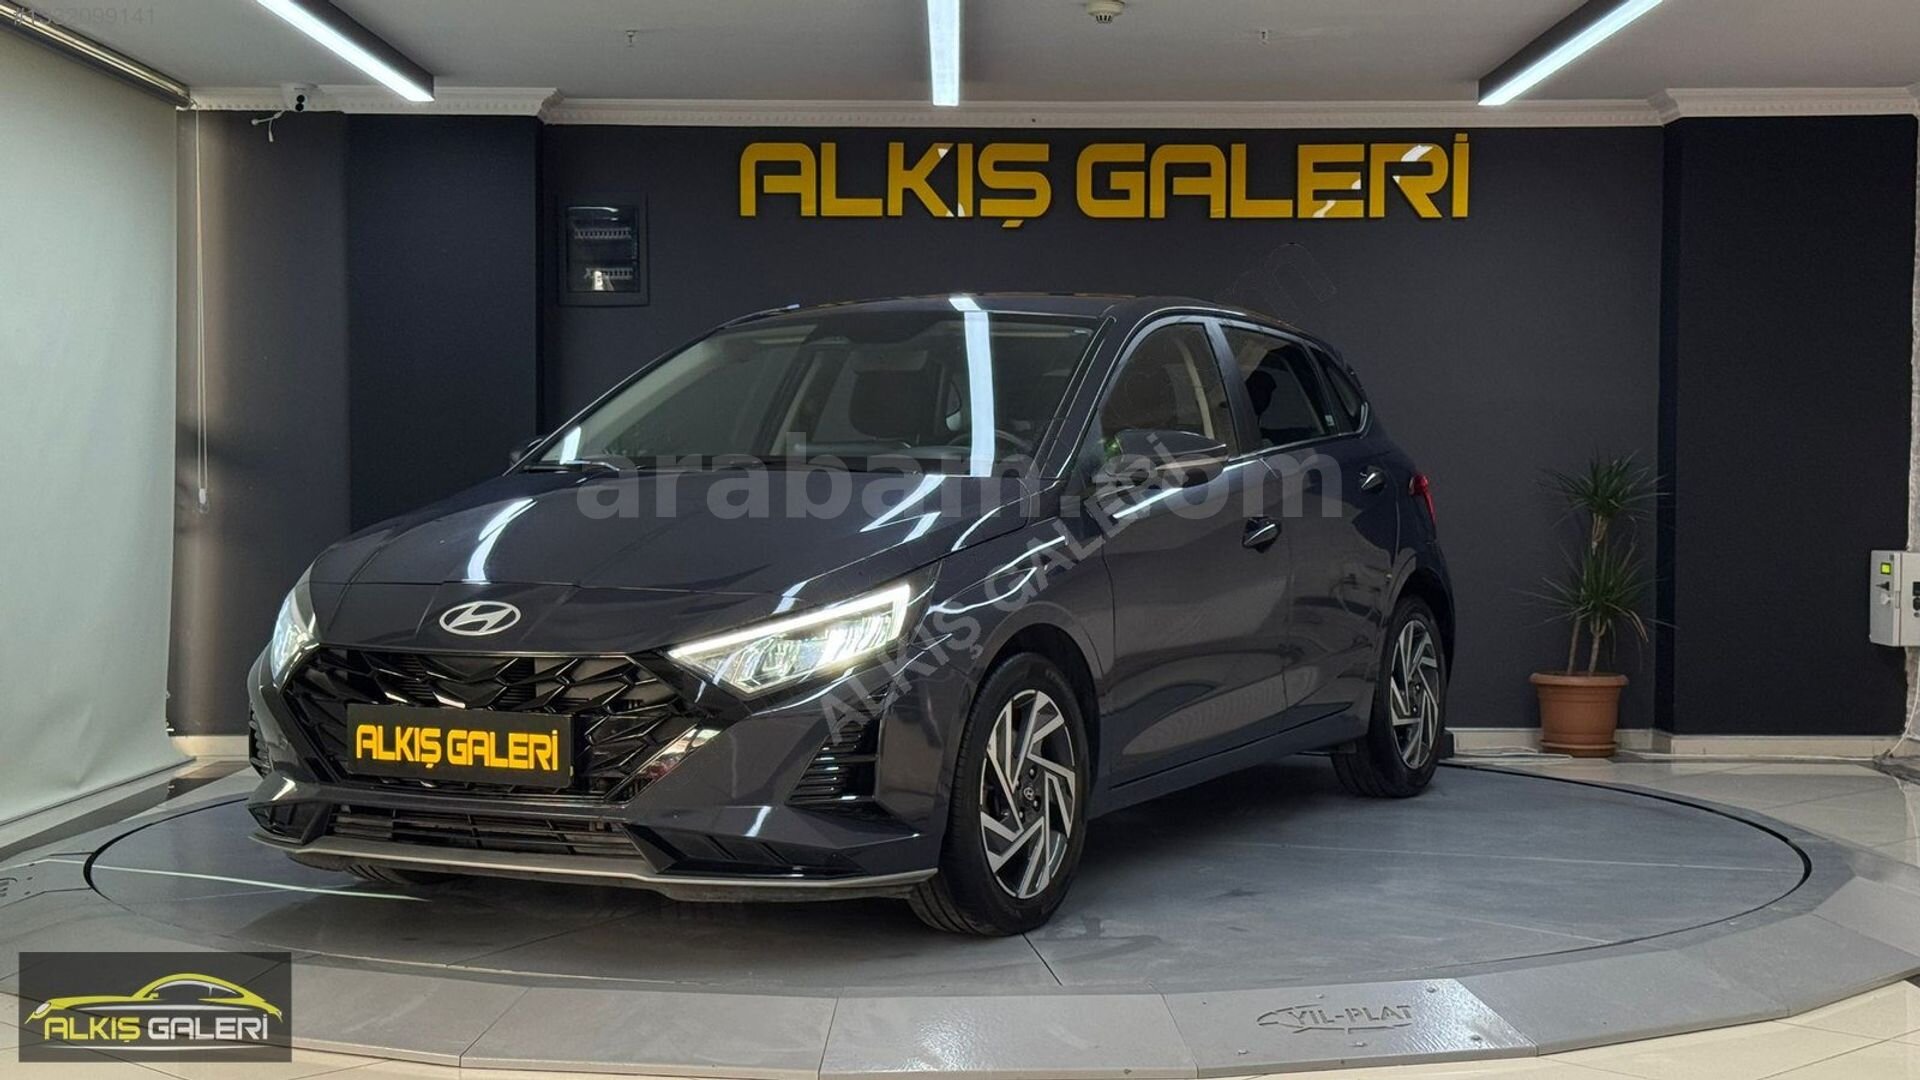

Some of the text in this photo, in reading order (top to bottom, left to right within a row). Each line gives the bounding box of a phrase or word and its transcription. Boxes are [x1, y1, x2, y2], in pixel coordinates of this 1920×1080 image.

[740, 133, 1468, 229] ALKIŞ GALERİ
[356, 724, 559, 772] ALKIŞ GALERİ
[1287, 1004, 1413, 1026] YIL-PLAT
